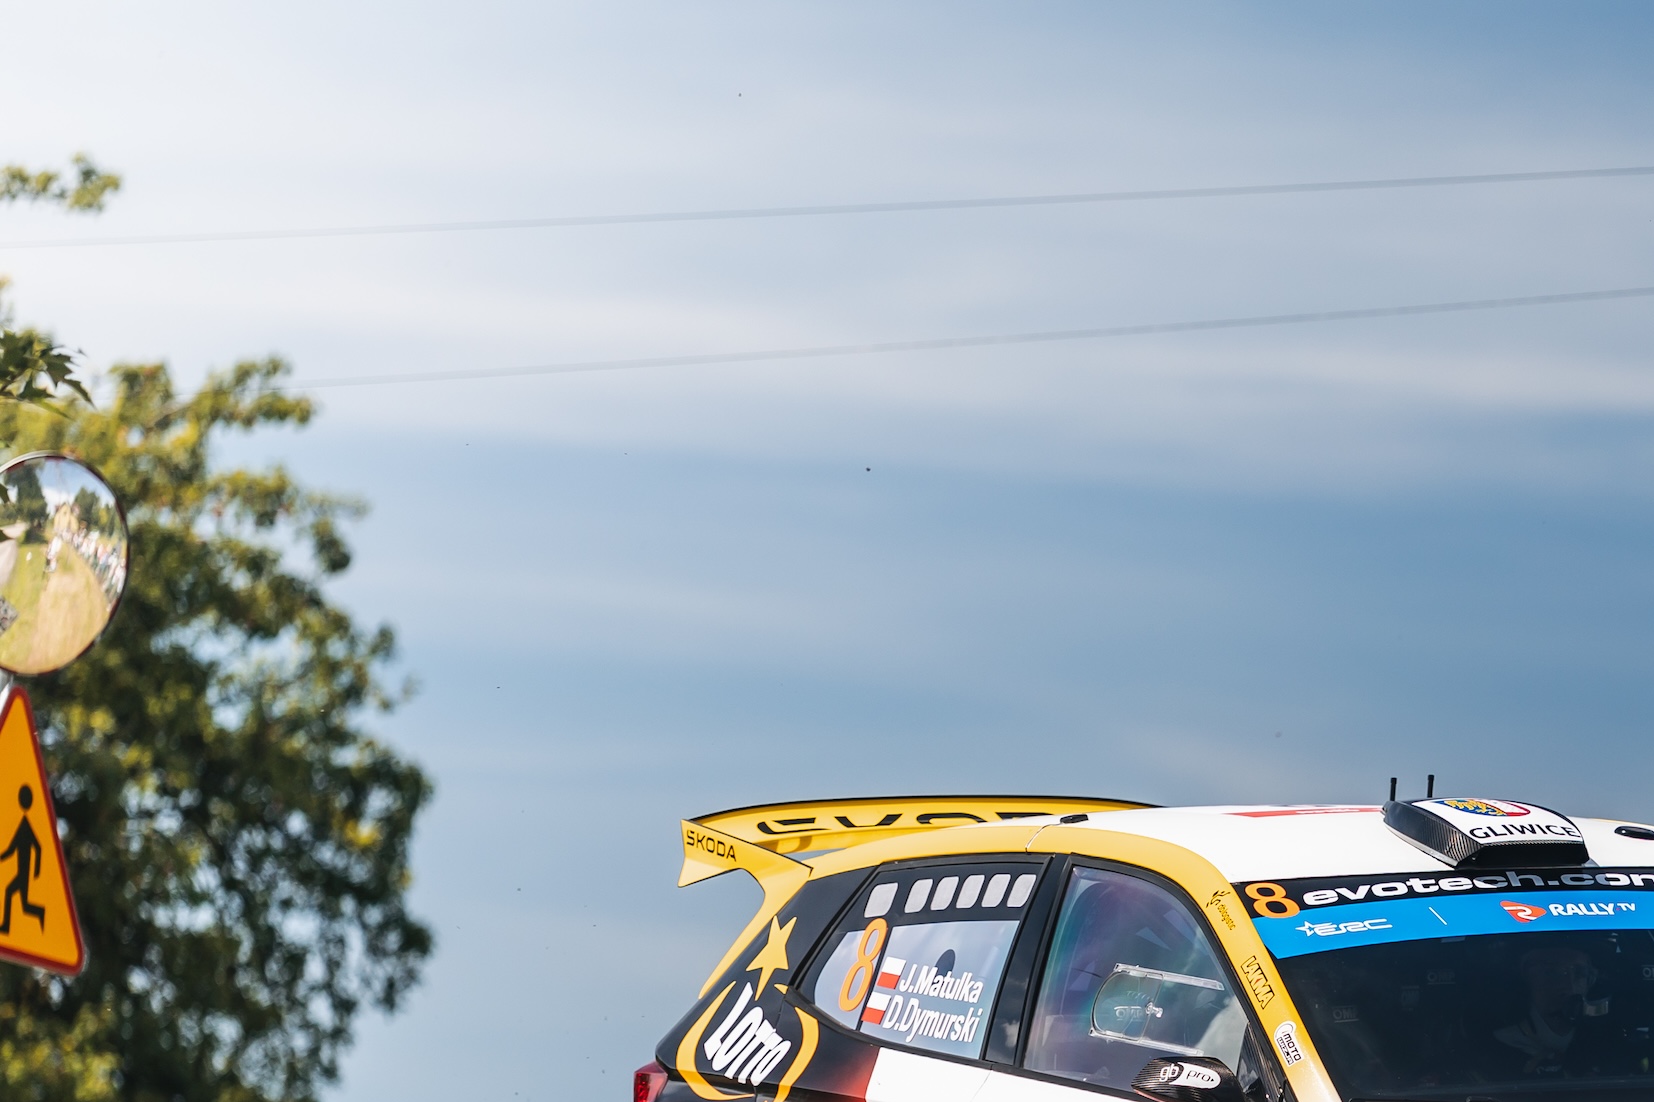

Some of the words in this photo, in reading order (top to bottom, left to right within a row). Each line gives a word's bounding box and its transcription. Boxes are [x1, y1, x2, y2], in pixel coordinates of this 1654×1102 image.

[1469, 823, 1581, 839] GLIWICE
[1244, 882, 1300, 918] 8
[838, 918, 888, 1012] 8
[899, 963, 984, 1004] J.Matulka
[1240, 955, 1276, 1010] LAKMA
[704, 982, 792, 1086] LOTTO
[882, 995, 984, 1043] D.Dymurski
